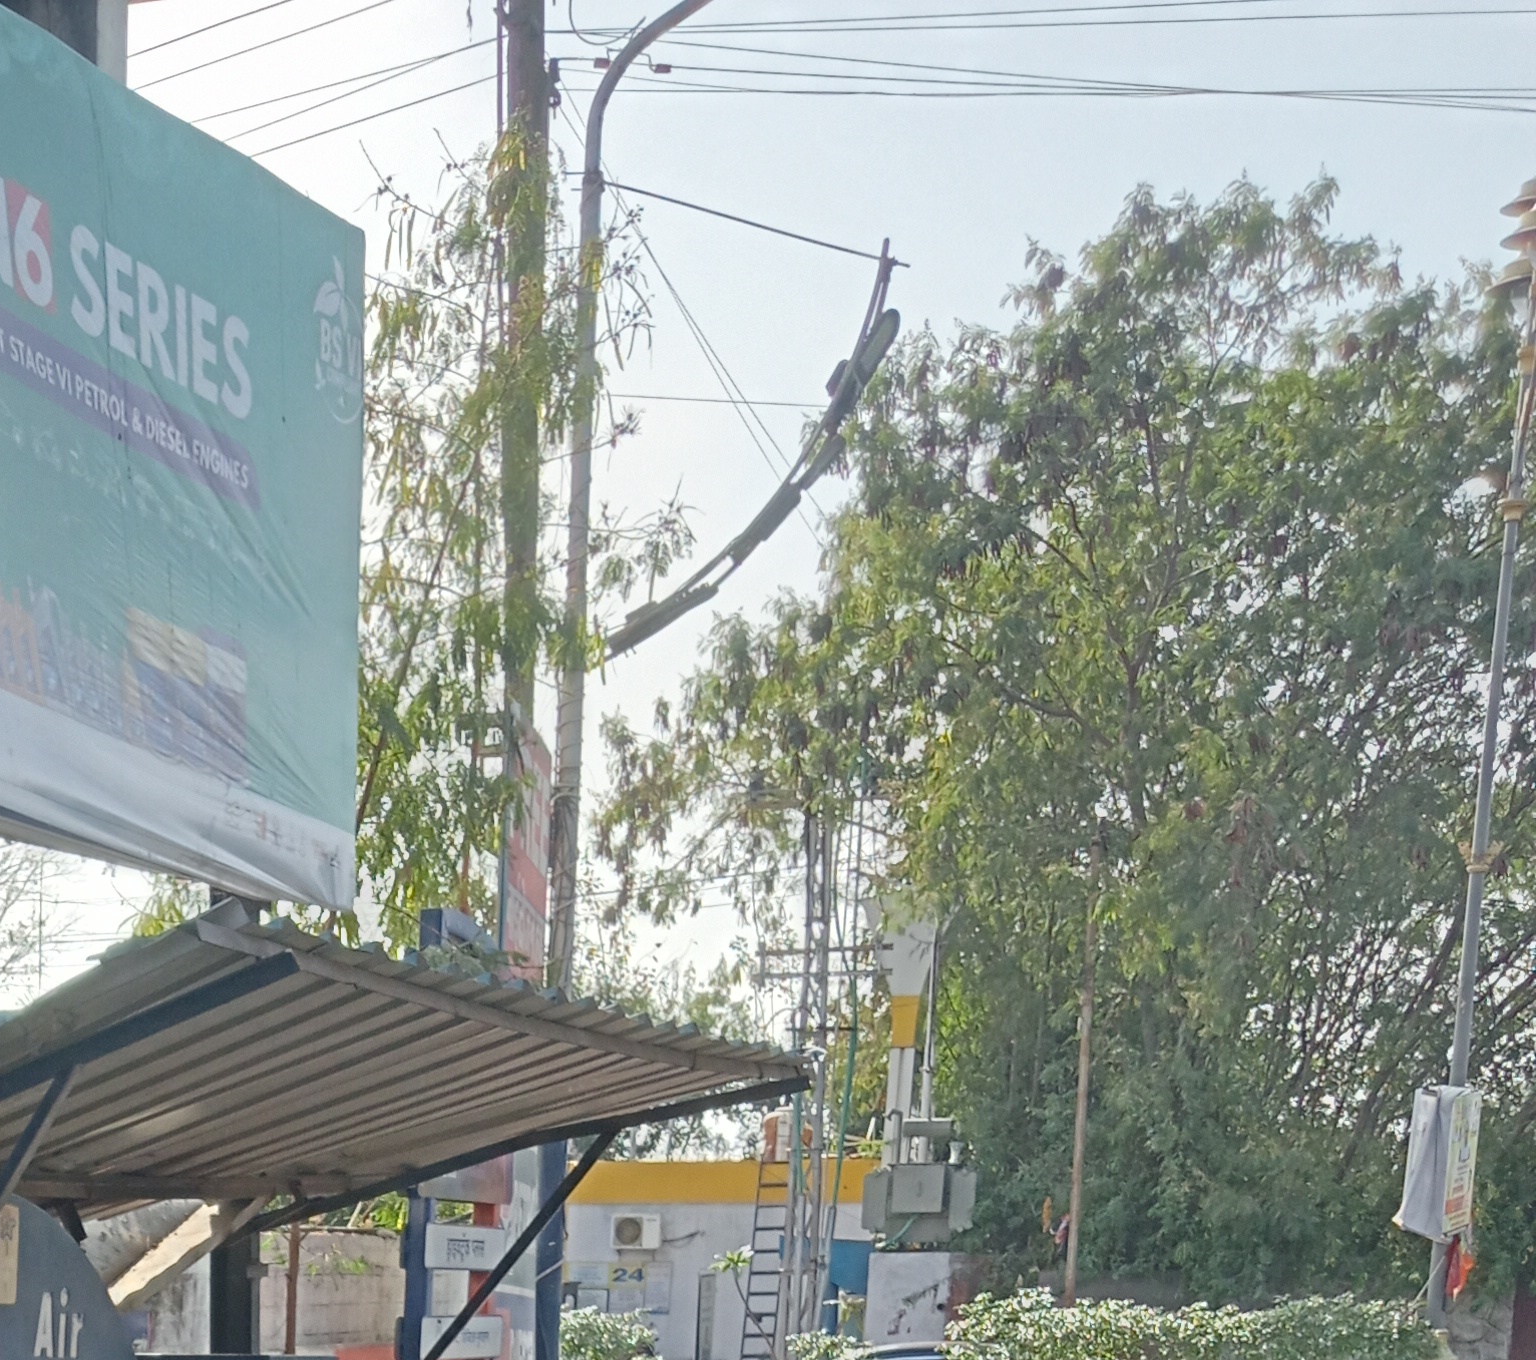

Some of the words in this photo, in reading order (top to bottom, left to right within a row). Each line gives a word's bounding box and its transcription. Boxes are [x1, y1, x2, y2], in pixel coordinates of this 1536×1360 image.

[70, 224, 253, 420] SERIES
[320, 318, 343, 370] BS
[9, 334, 56, 386] STAGE
[56, 362, 72, 396] VI
[75, 374, 128, 427] PETROL
[132, 406, 144, 436] &
[145, 415, 191, 460] DIESEL
[192, 438, 249, 490] ENGINES
[612, 1268, 645, 1283] 24
[34, 1287, 84, 1359] Air
